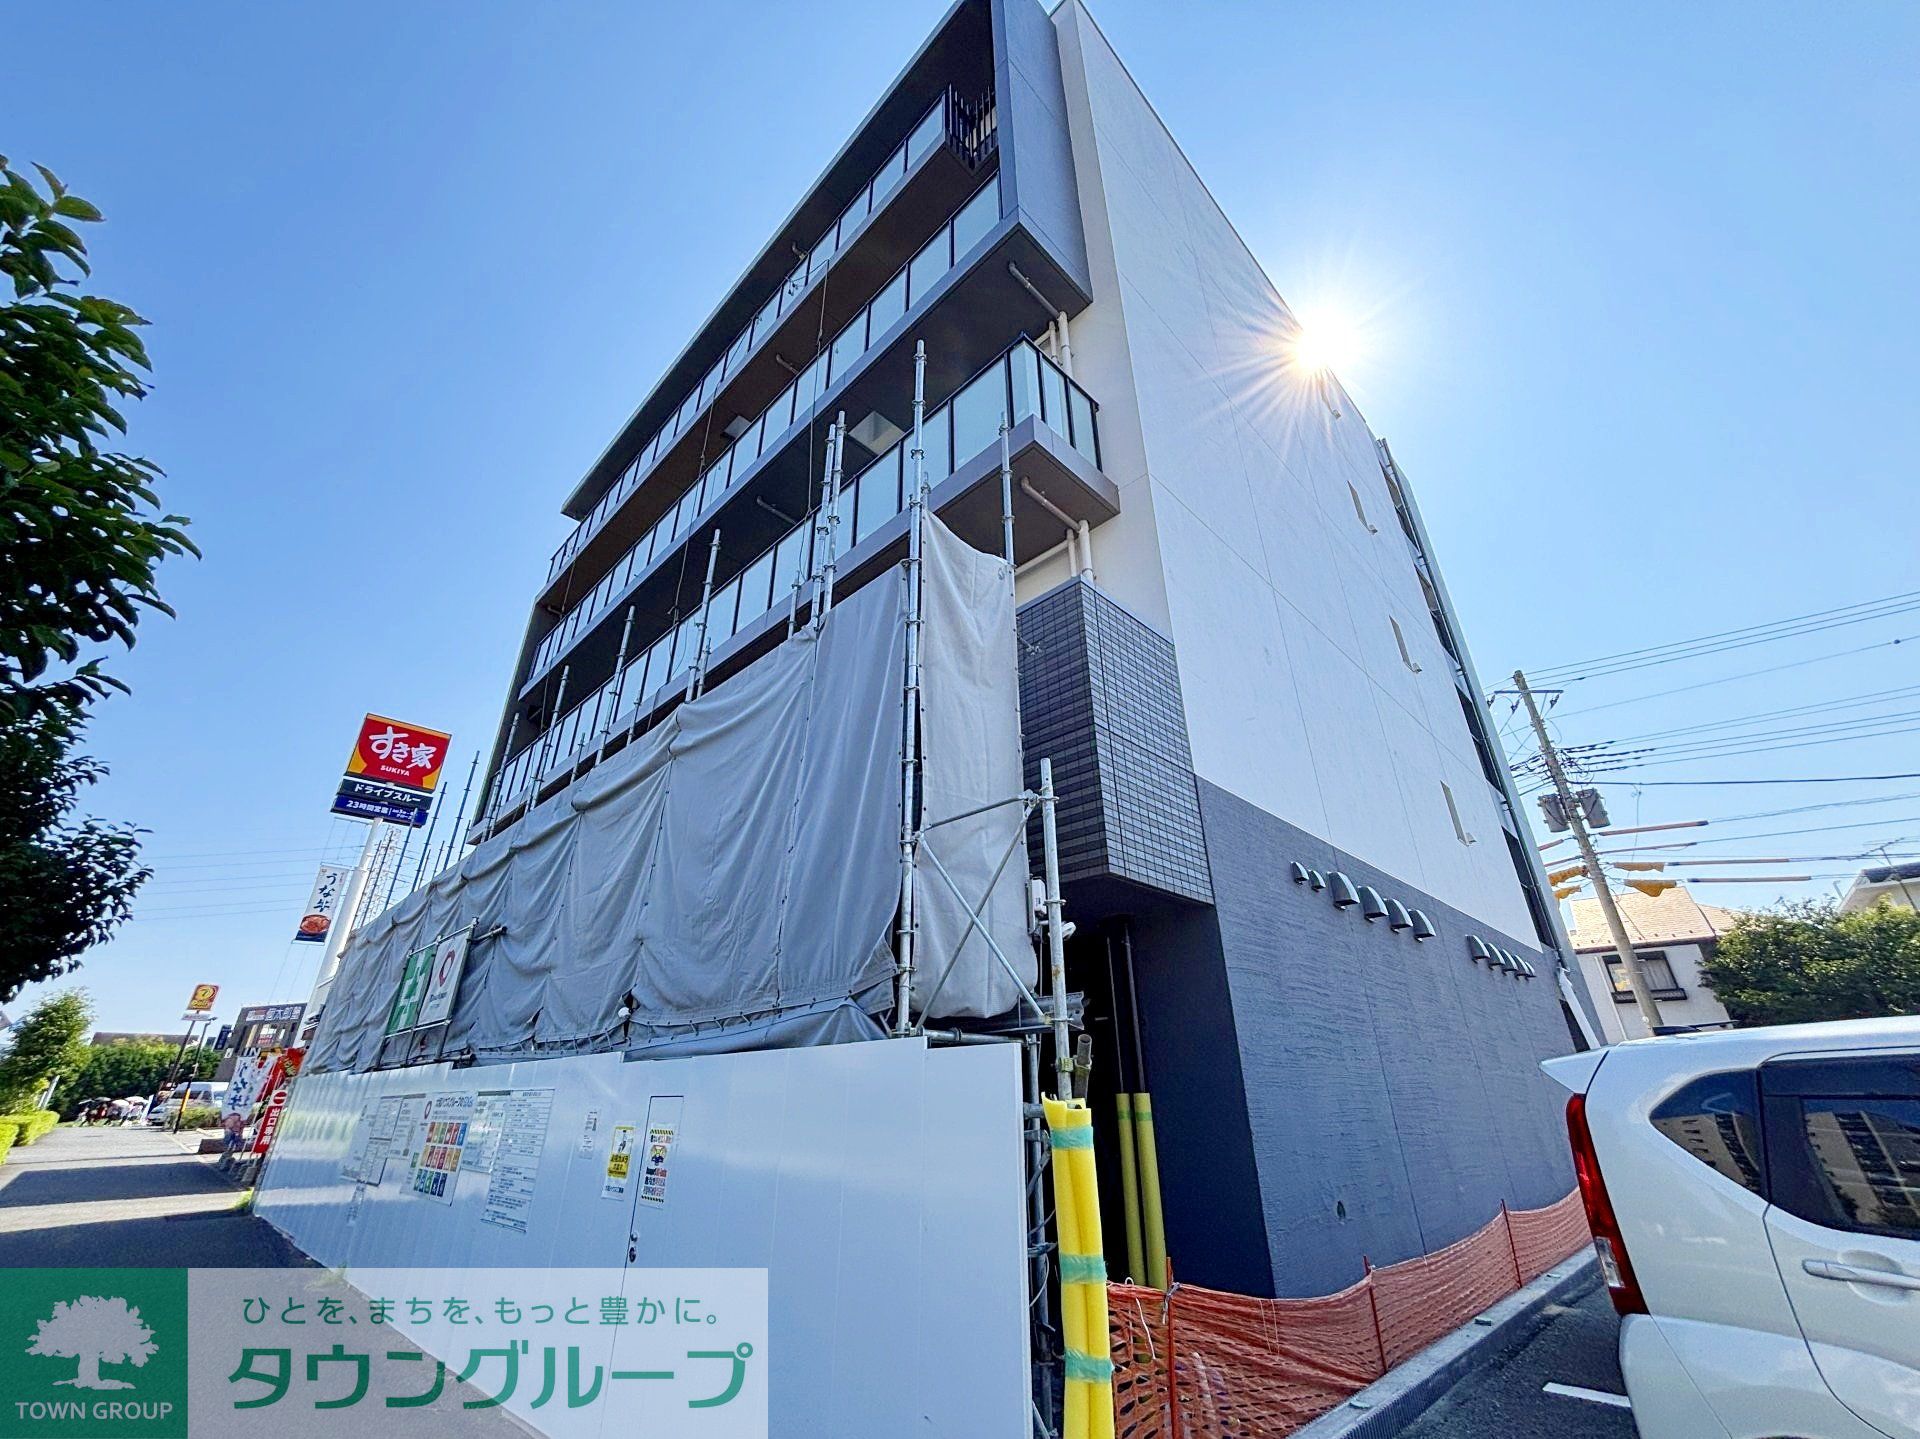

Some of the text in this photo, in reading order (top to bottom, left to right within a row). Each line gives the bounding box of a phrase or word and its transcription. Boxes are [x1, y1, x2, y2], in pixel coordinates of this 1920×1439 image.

[368, 725, 437, 769] すき家
[380, 765, 410, 777] SUKIYA
[354, 783, 421, 803] ドライブスルー
[313, 872, 338, 912] うな牛
